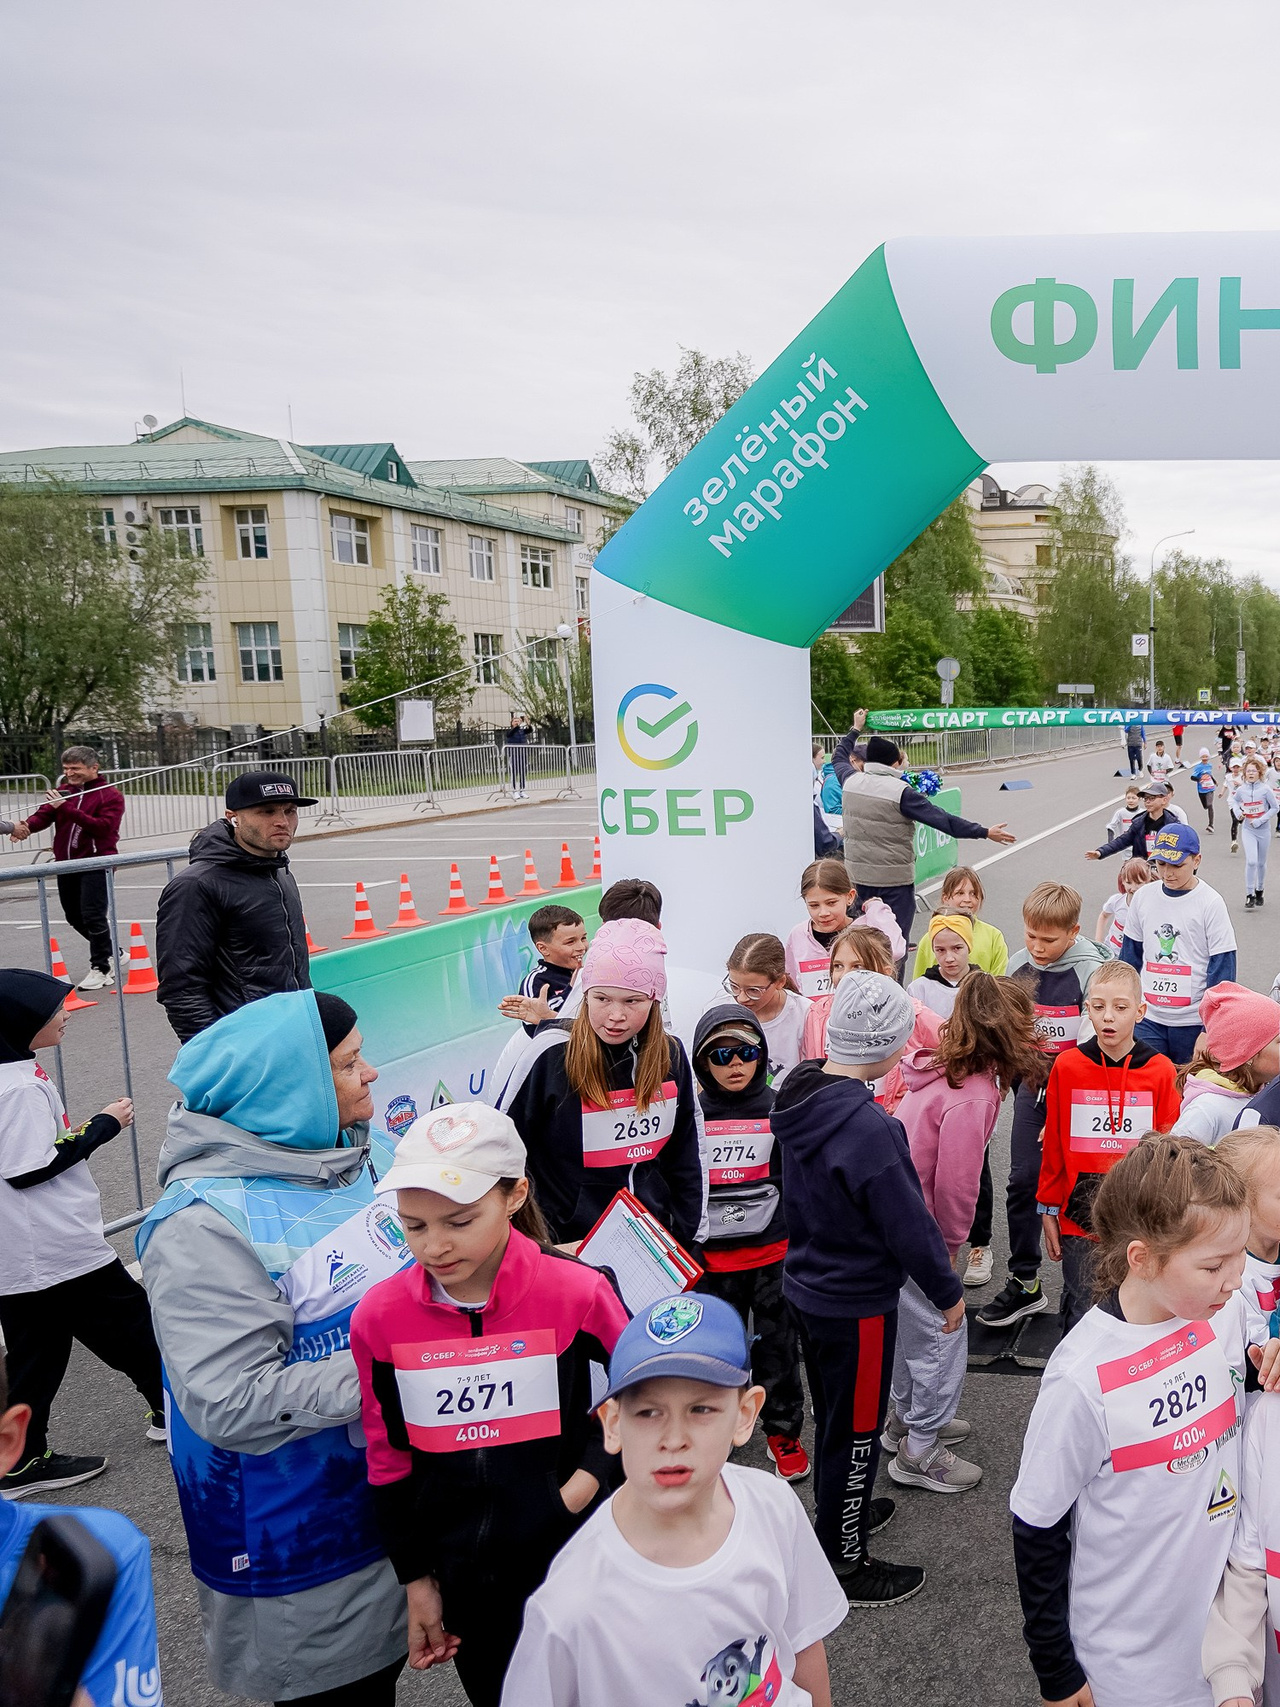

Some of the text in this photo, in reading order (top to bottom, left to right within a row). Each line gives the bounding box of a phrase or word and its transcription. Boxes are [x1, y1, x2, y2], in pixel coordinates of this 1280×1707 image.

[682, 351, 839, 526] зелёный
[707, 385, 869, 559] марафон
[922, 711, 989, 729] СТАРТ
[1001, 710, 1070, 726] СТАРТ
[1083, 709, 1153, 724] СТАРТ
[1166, 710, 1237, 725] СТАРТ
[600, 787, 755, 836] СБЕР
[1152, 980, 1178, 993] 2673
[613, 1116, 661, 1142] 2639
[626, 1146, 653, 1159] 400м
[1100, 1140, 1123, 1149] 400м
[712, 1145, 757, 1163] 2774
[721, 1169, 745, 1180] 400м
[433, 1350, 456, 1360] СБЕР
[1138, 1358, 1154, 1372] СБЕР
[457, 1373, 491, 1384] 7-9 ЛЕТ
[1174, 1371, 1187, 1384] ЛЕТ
[436, 1380, 514, 1416] 2671
[1148, 1374, 1207, 1428] 2829
[455, 1424, 500, 1443] 400м
[1172, 1426, 1206, 1452] 400м
